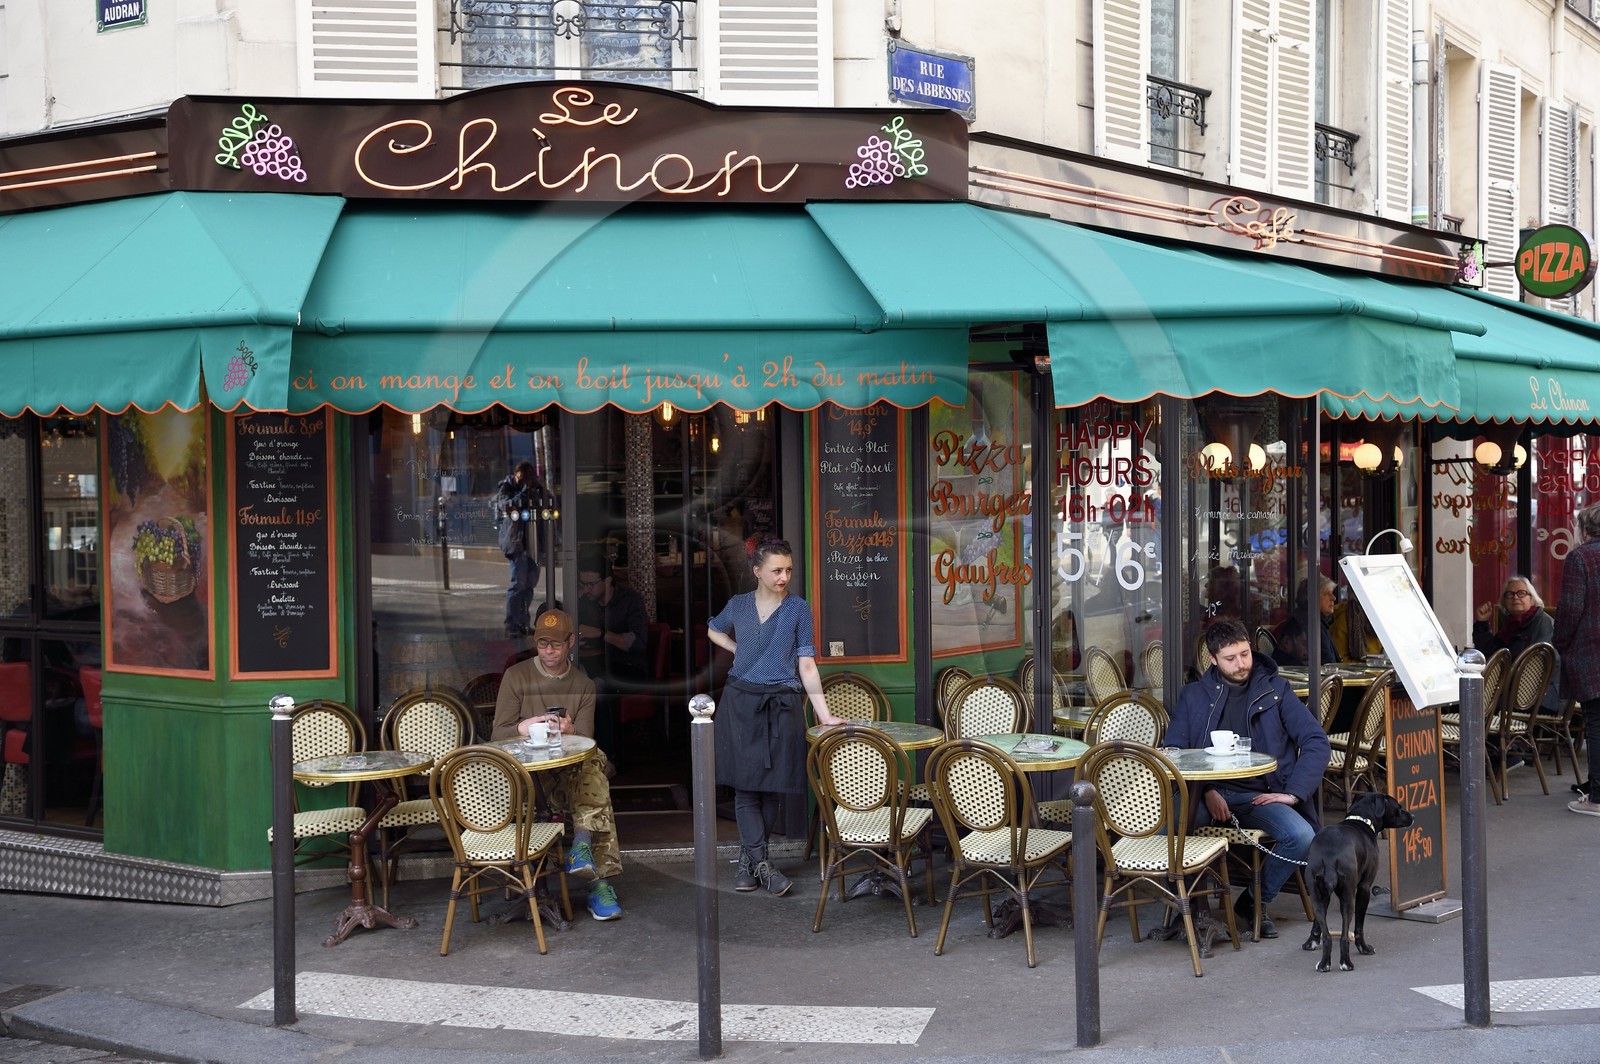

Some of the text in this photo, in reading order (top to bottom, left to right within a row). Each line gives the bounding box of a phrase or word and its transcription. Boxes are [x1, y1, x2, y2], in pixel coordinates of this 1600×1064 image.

[104, 2, 140, 23] AUDRAN
[919, 60, 945, 79] RUE
[892, 76, 971, 104] DES ABBESSES
[538, 86, 638, 126] Le
[354, 116, 800, 197] Chinon
[1519, 241, 1586, 283] PIZZA
[292, 353, 938, 404] ci on mange et on boit jusqu'à 2h du matin
[1530, 375, 1590, 412] Le Chinon
[238, 417, 297, 436] Formule
[1056, 420, 1154, 452] HAPPY
[248, 451, 276, 461] Boisson
[279, 452, 303, 460] chaude
[824, 442, 857, 454] Entrée
[865, 440, 891, 454] Plat
[932, 429, 1027, 475] Pizza
[820, 460, 844, 474] Plat
[850, 461, 894, 474] Dessert
[1056, 454, 1155, 488] HOURS
[1185, 450, 1240, 480] Plats
[249, 479, 277, 489] Tartine
[238, 503, 293, 526] Formule
[824, 508, 888, 529] Formule
[929, 480, 1033, 534] Burger
[249, 542, 276, 551] Boisson
[279, 542, 303, 551] chaude
[826, 528, 876, 556] Pizza
[830, 550, 863, 566] Pizza
[251, 566, 280, 576] Tartine
[833, 568, 882, 581] boisson
[934, 547, 1033, 606] Gaufres
[270, 580, 300, 589] Croissant
[1394, 727, 1437, 760] CHINON
[1411, 764, 1420, 775] OU
[1396, 778, 1438, 813] PIZZA
